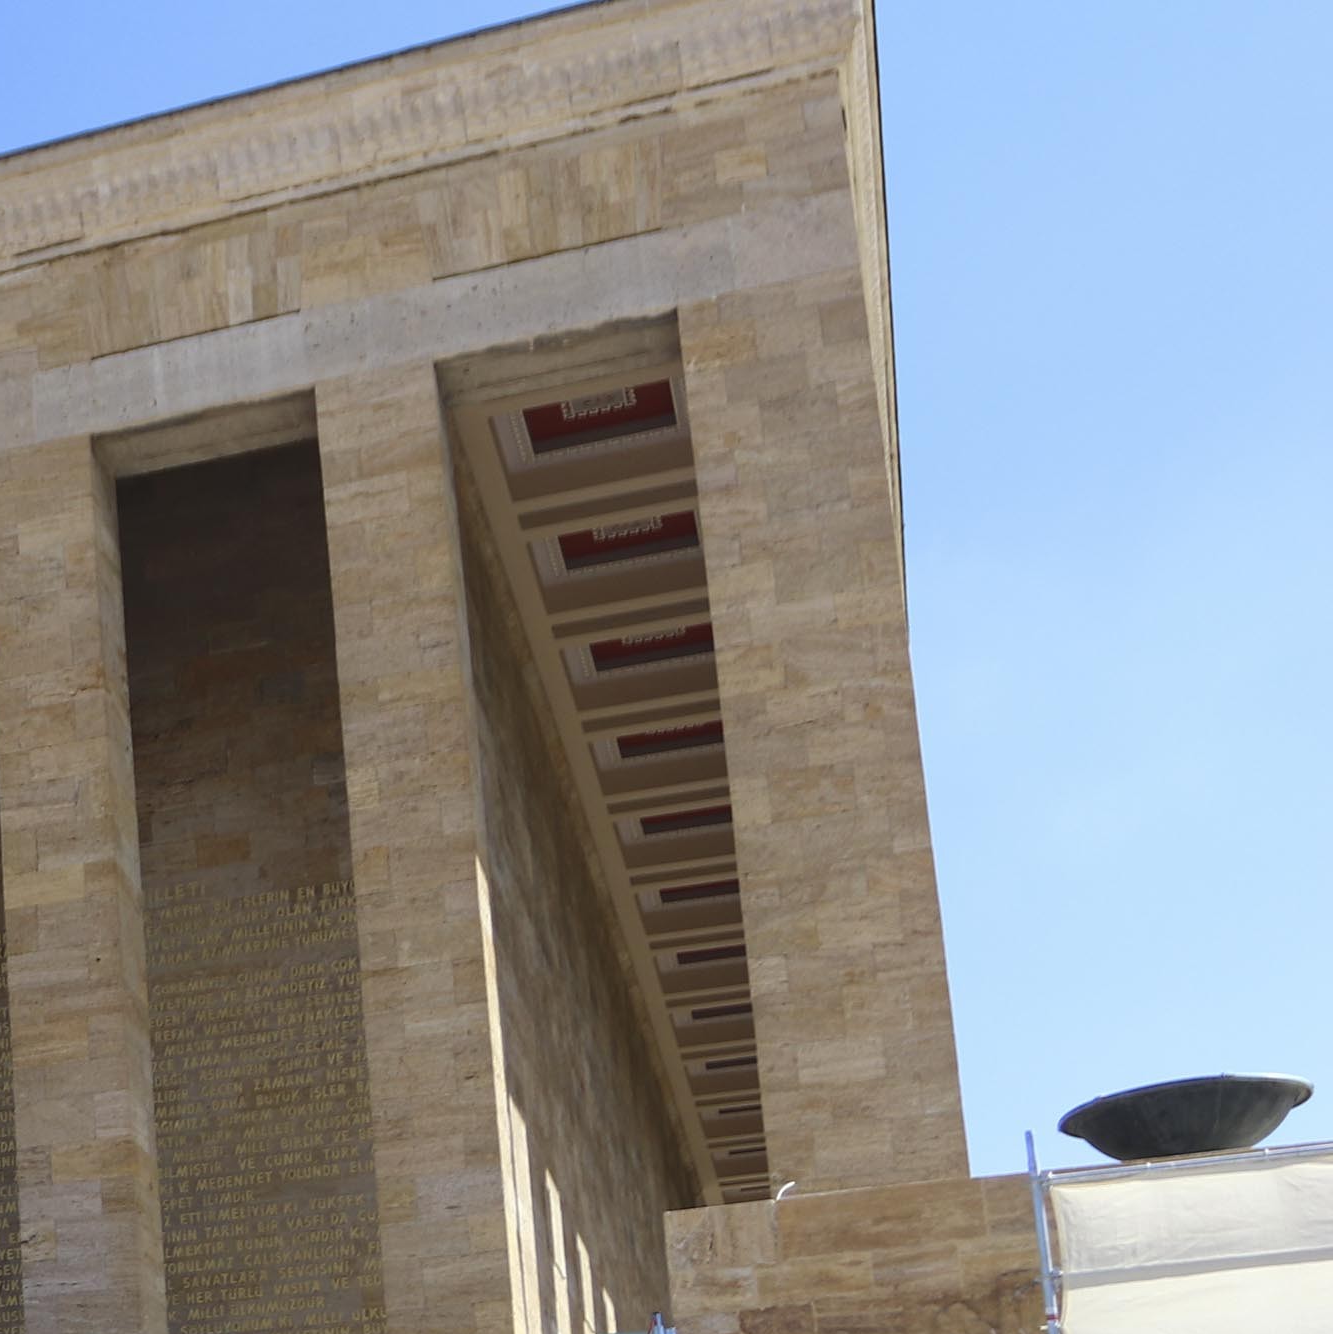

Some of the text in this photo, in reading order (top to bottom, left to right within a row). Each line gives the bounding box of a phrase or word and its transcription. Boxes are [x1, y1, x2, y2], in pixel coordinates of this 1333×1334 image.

[238, 1157, 256, 1171] VE
[182, 1271, 269, 1290] SANATLARA
[187, 1290, 213, 1305] HER
[331, 1277, 349, 1290] VE
